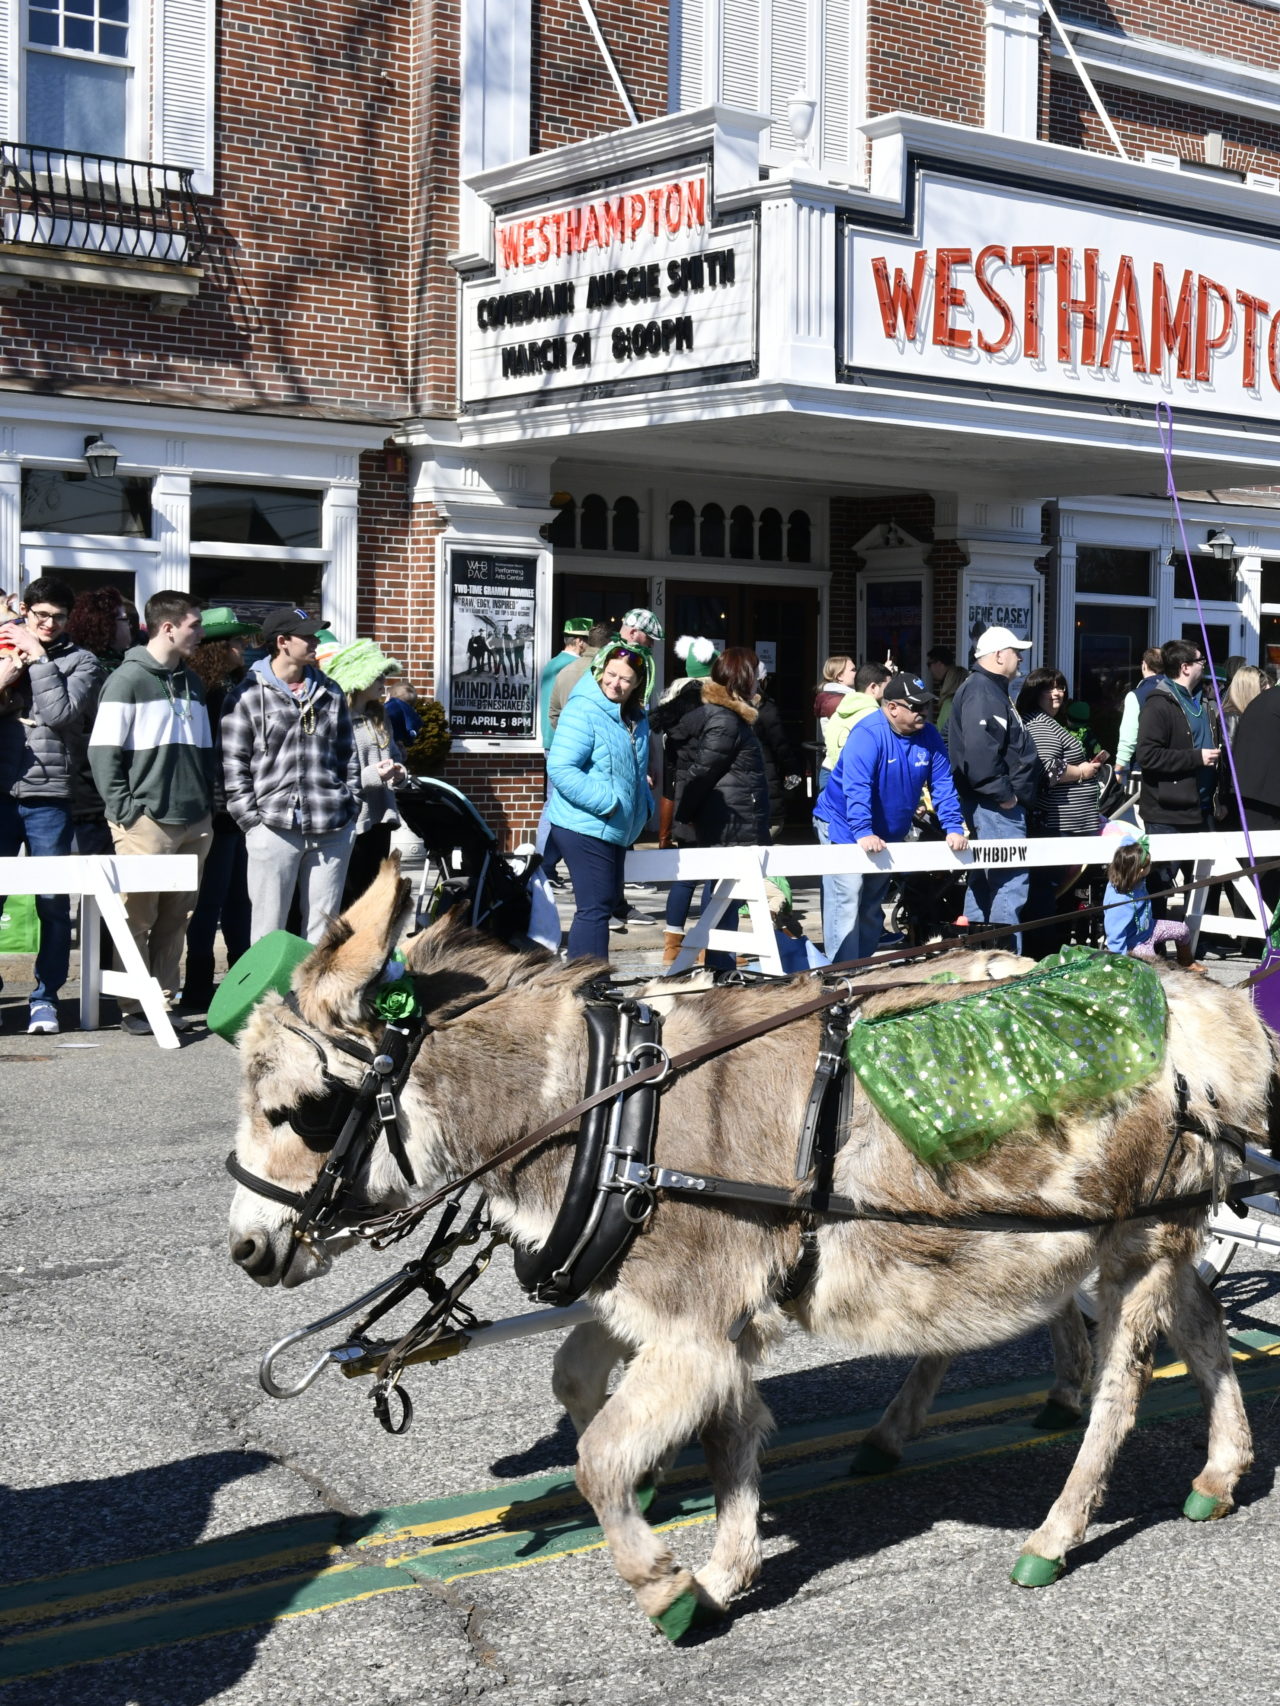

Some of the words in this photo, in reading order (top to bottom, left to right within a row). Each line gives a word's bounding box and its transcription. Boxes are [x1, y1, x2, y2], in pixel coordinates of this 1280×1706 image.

[495, 178, 705, 271] WESTHAMPTON
[586, 264, 661, 312] AUGGIE
[667, 248, 735, 298] SMITH
[502, 337, 567, 379] MARCH
[572, 332, 591, 367] 21
[611, 315, 694, 361] 8:00PM
[468, 570, 488, 580] PAC
[968, 605, 993, 622] GENE
[996, 607, 1030, 624] CASEY
[454, 681, 492, 699] MINDI
[494, 684, 530, 701] ABAIR
[452, 716, 466, 725] FRI
[471, 716, 500, 726] APRIL
[500, 719, 506, 728] 5
[512, 718, 532, 727] 8PM
[972, 846, 1027, 862] WHBDPW
